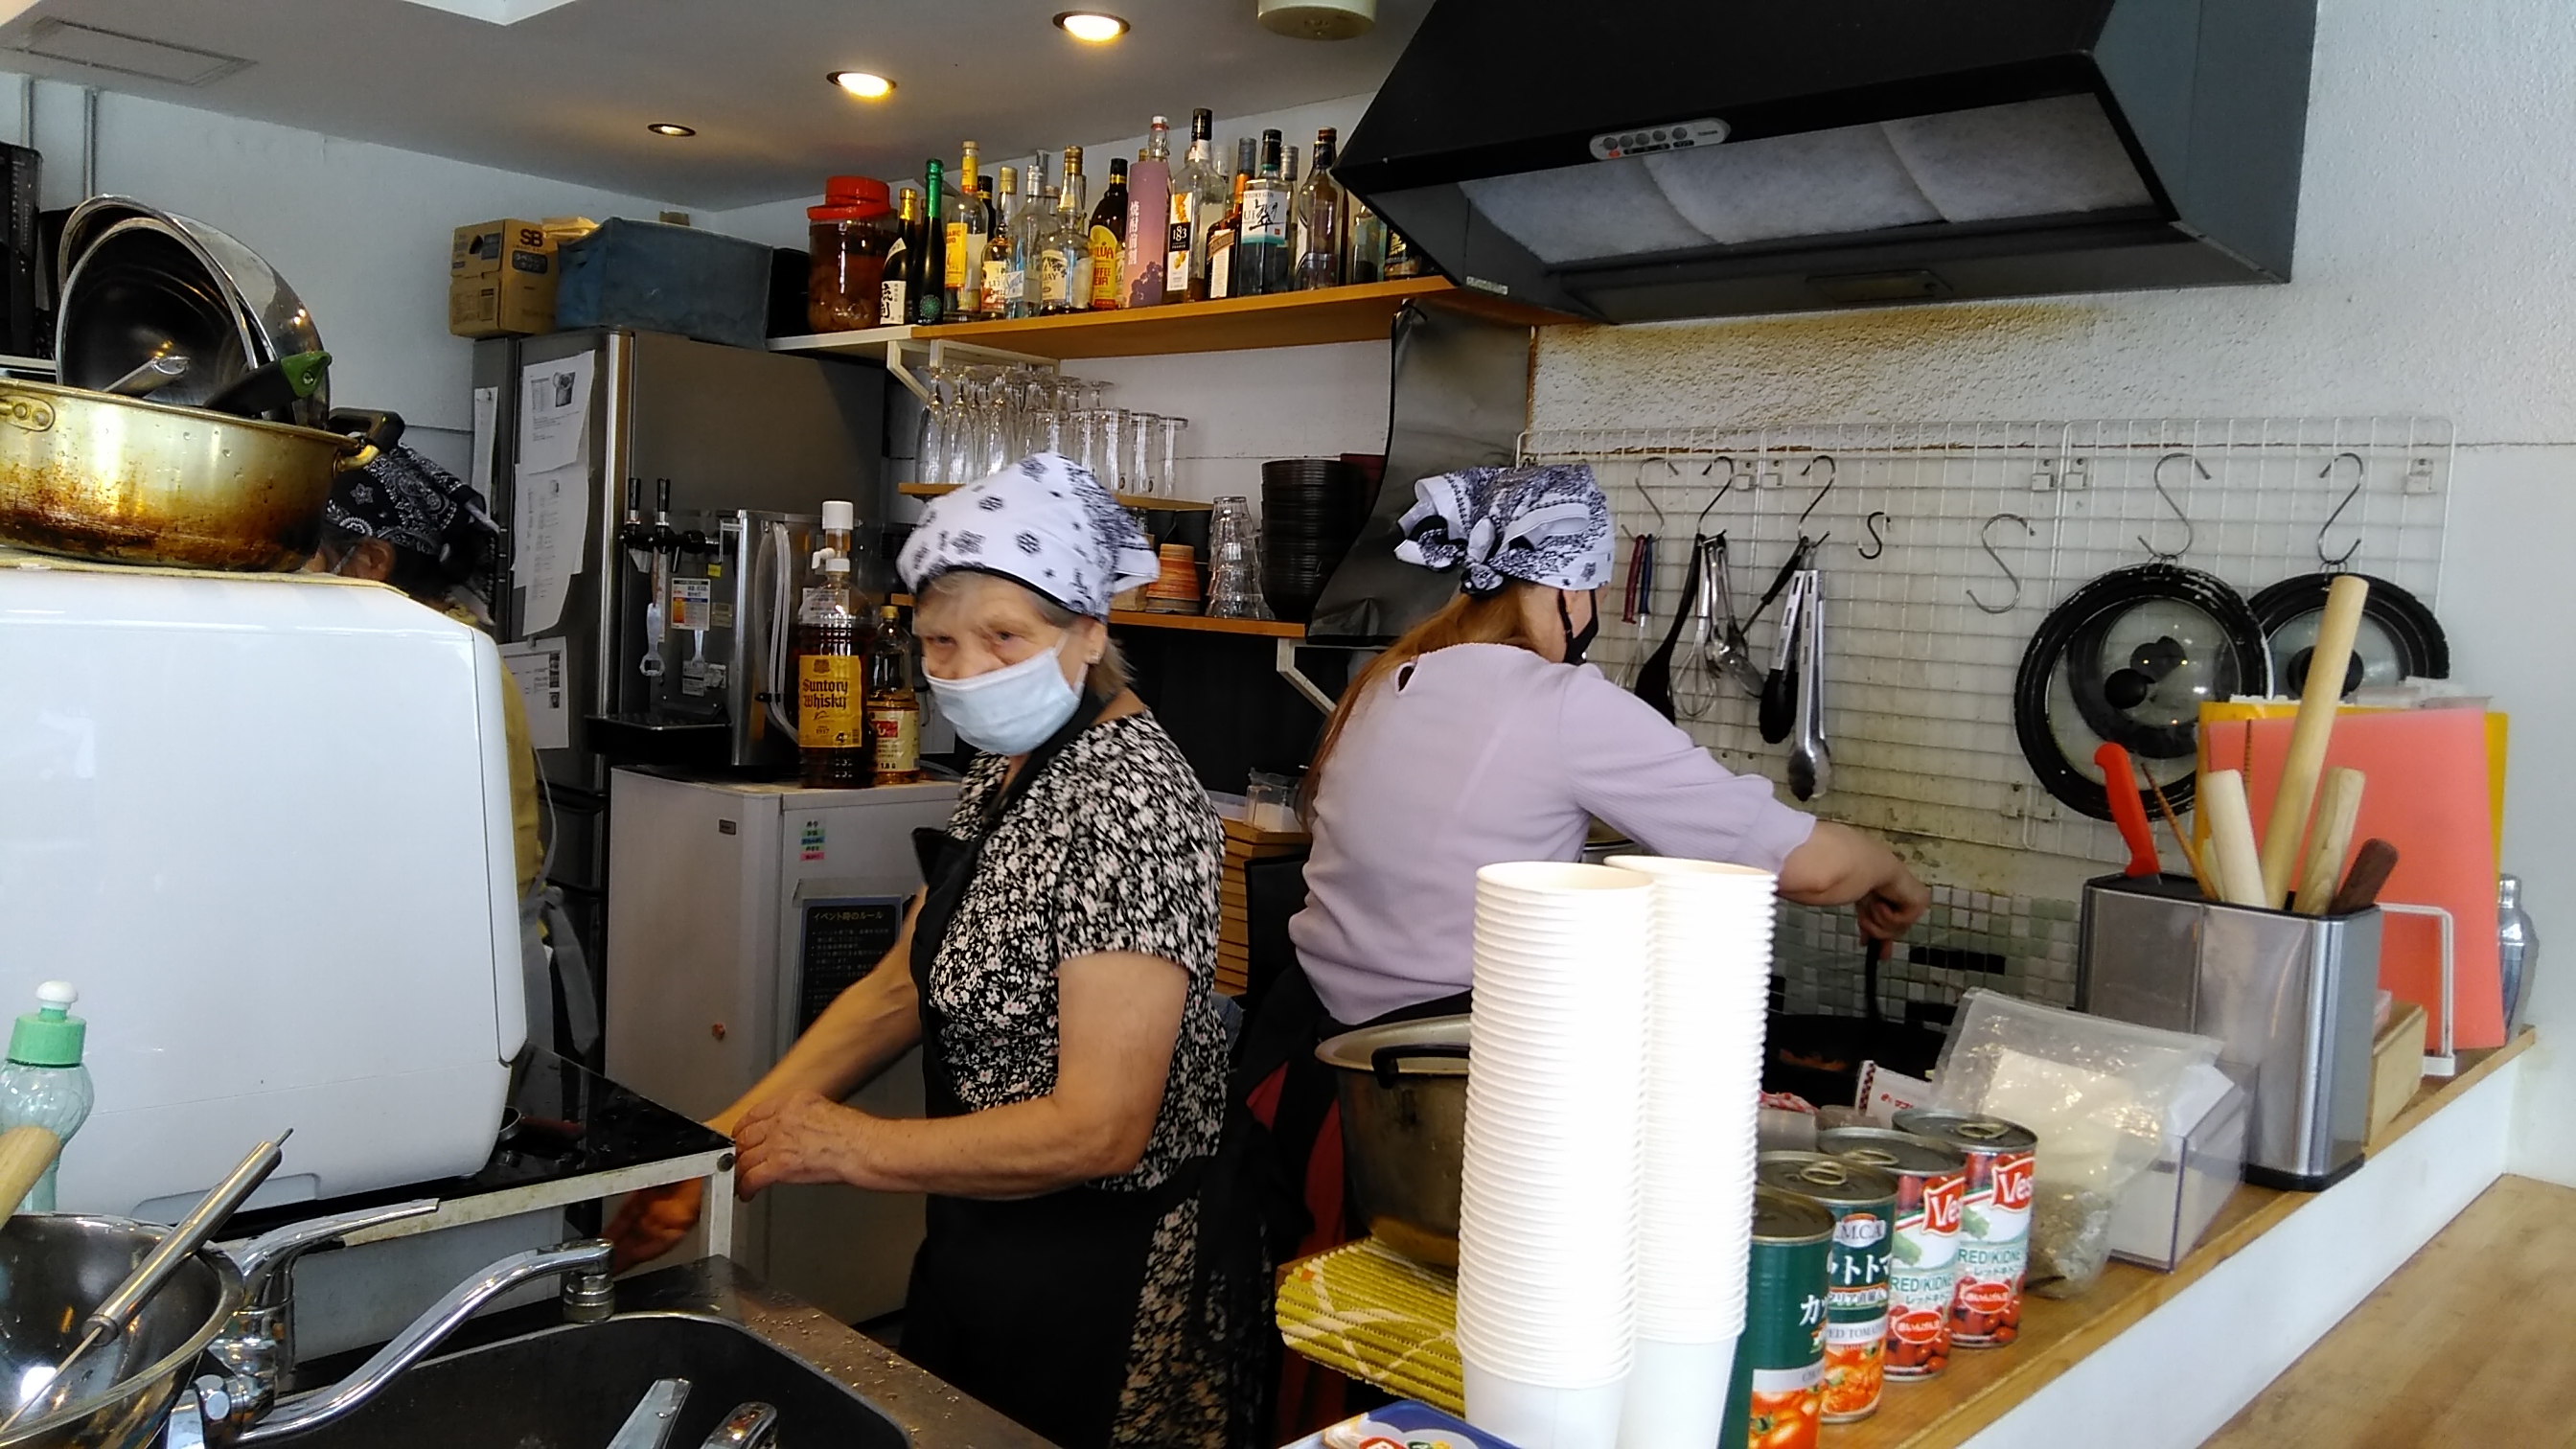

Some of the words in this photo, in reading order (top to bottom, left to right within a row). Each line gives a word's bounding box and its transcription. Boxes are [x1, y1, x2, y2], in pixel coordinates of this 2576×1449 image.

[520, 229, 543, 247] SB
[802, 678, 849, 696] Suntory
[803, 693, 847, 711] Whisky
[1958, 1249, 1988, 1264] RED
[1889, 1276, 1920, 1292] RED
